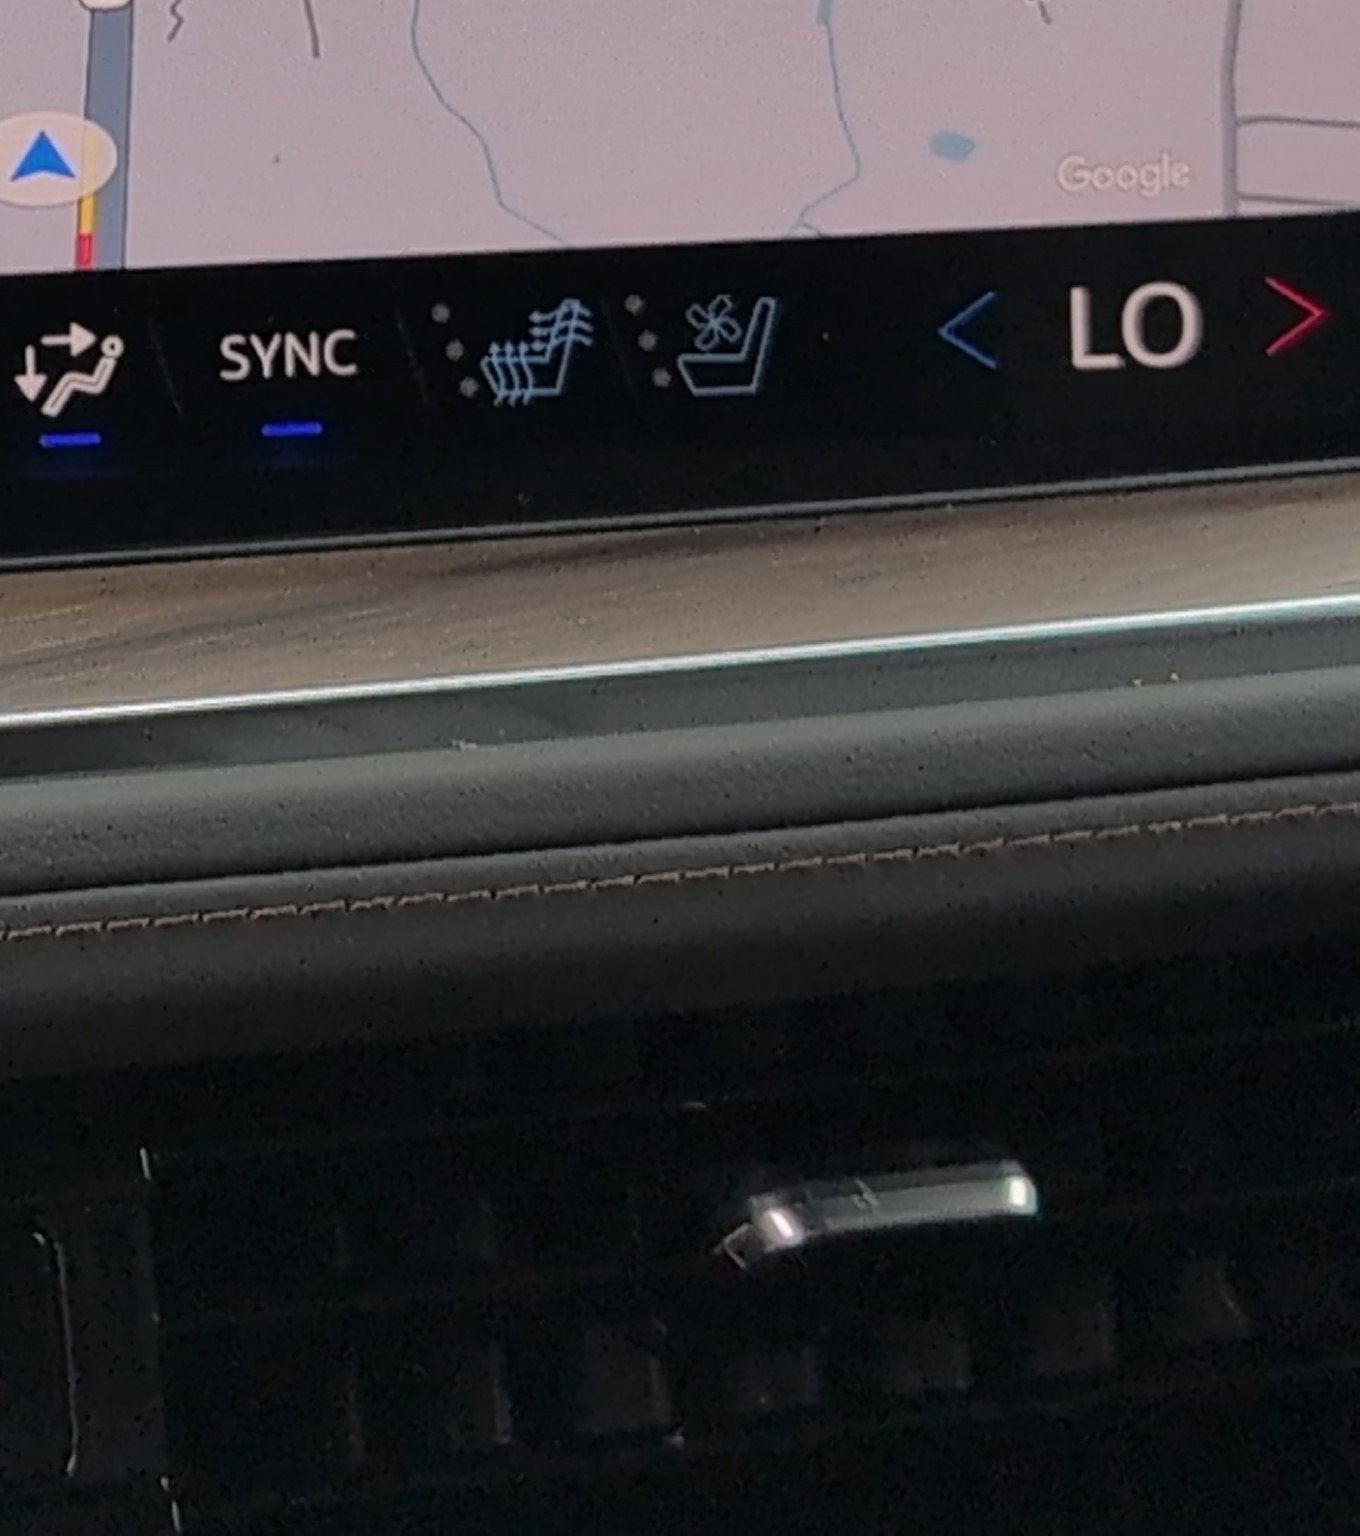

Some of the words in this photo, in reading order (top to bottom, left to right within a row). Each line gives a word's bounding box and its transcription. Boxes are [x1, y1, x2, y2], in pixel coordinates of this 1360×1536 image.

[1056, 152, 1190, 198] Google
[1070, 280, 1203, 370] LO
[219, 329, 357, 382] SYNC
